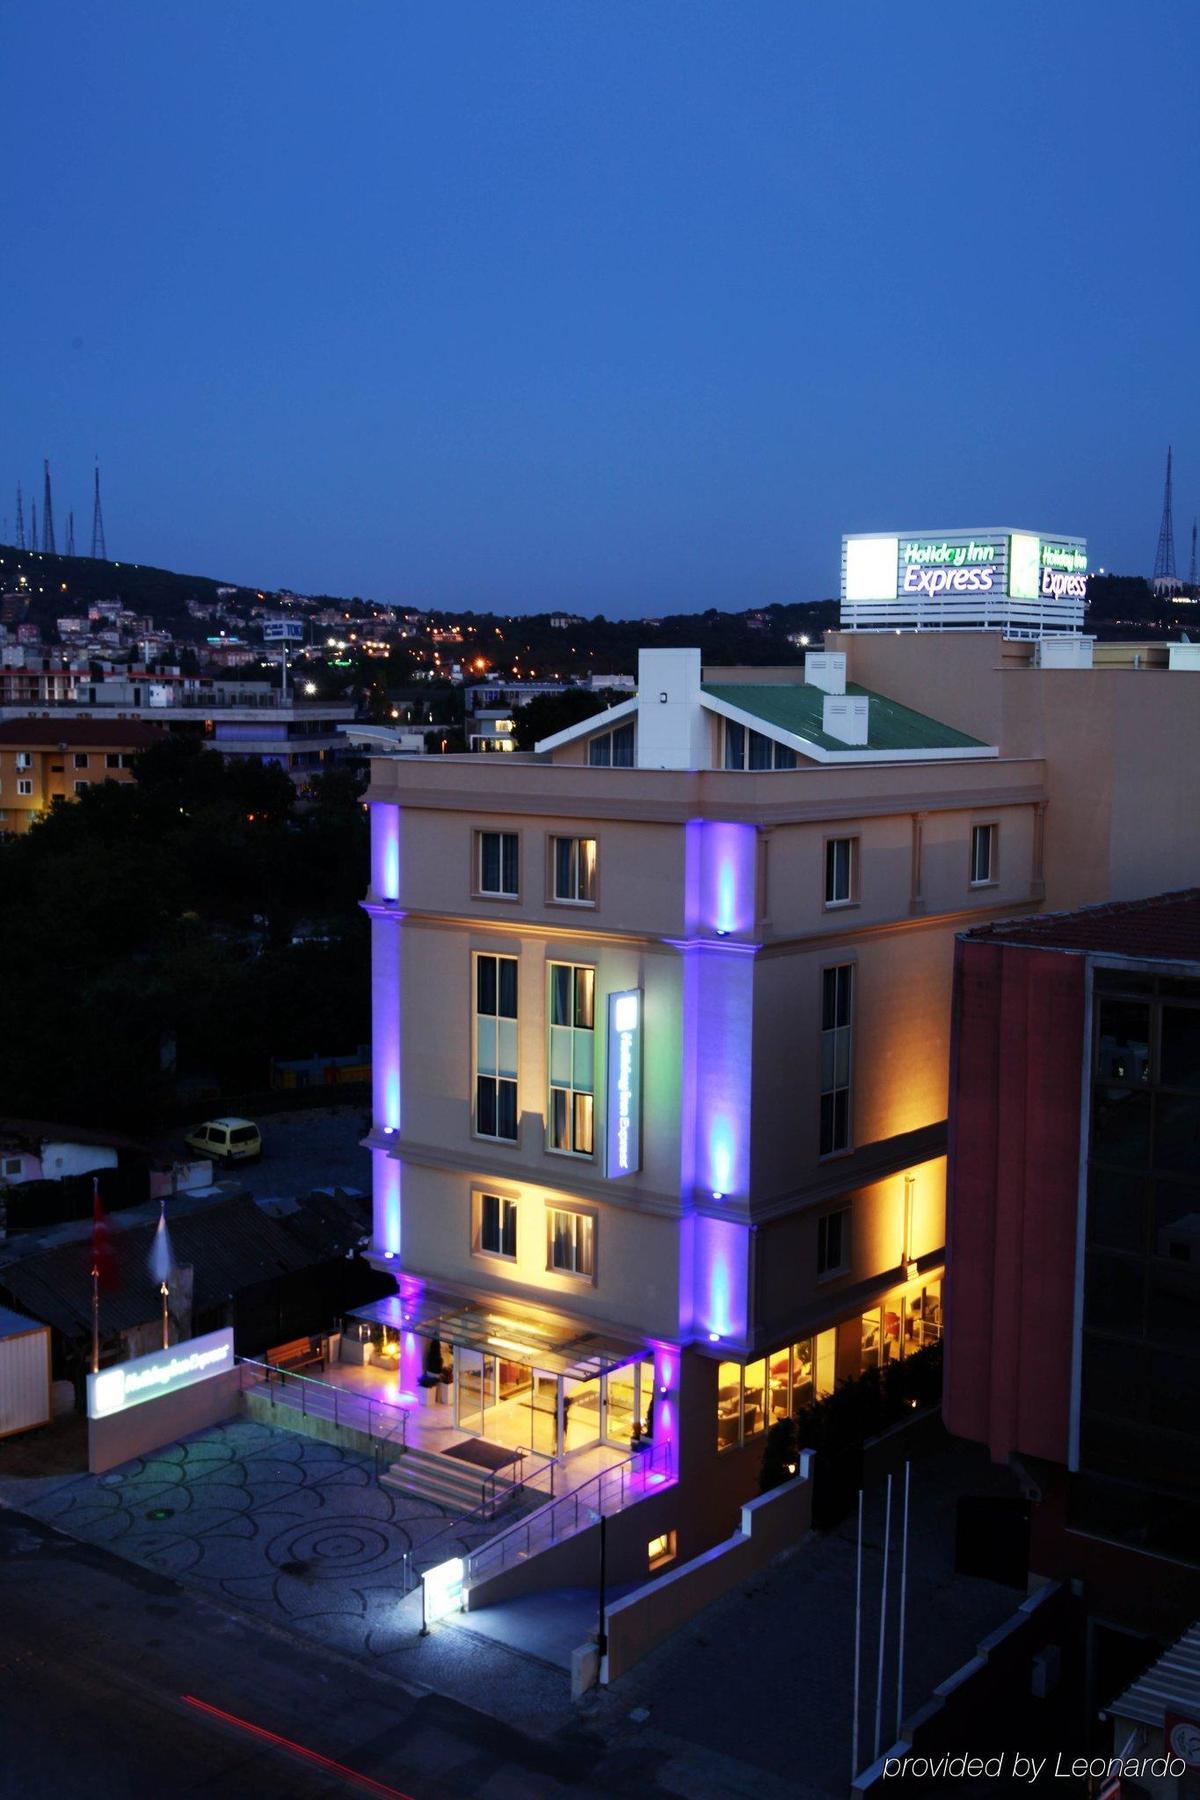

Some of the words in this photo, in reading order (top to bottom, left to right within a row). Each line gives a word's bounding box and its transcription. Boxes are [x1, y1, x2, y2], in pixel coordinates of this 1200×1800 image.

[904, 542, 967, 566] Holiday
[967, 541, 995, 561] Inn
[903, 564, 994, 598] Express
[1042, 567, 1088, 600] Express
